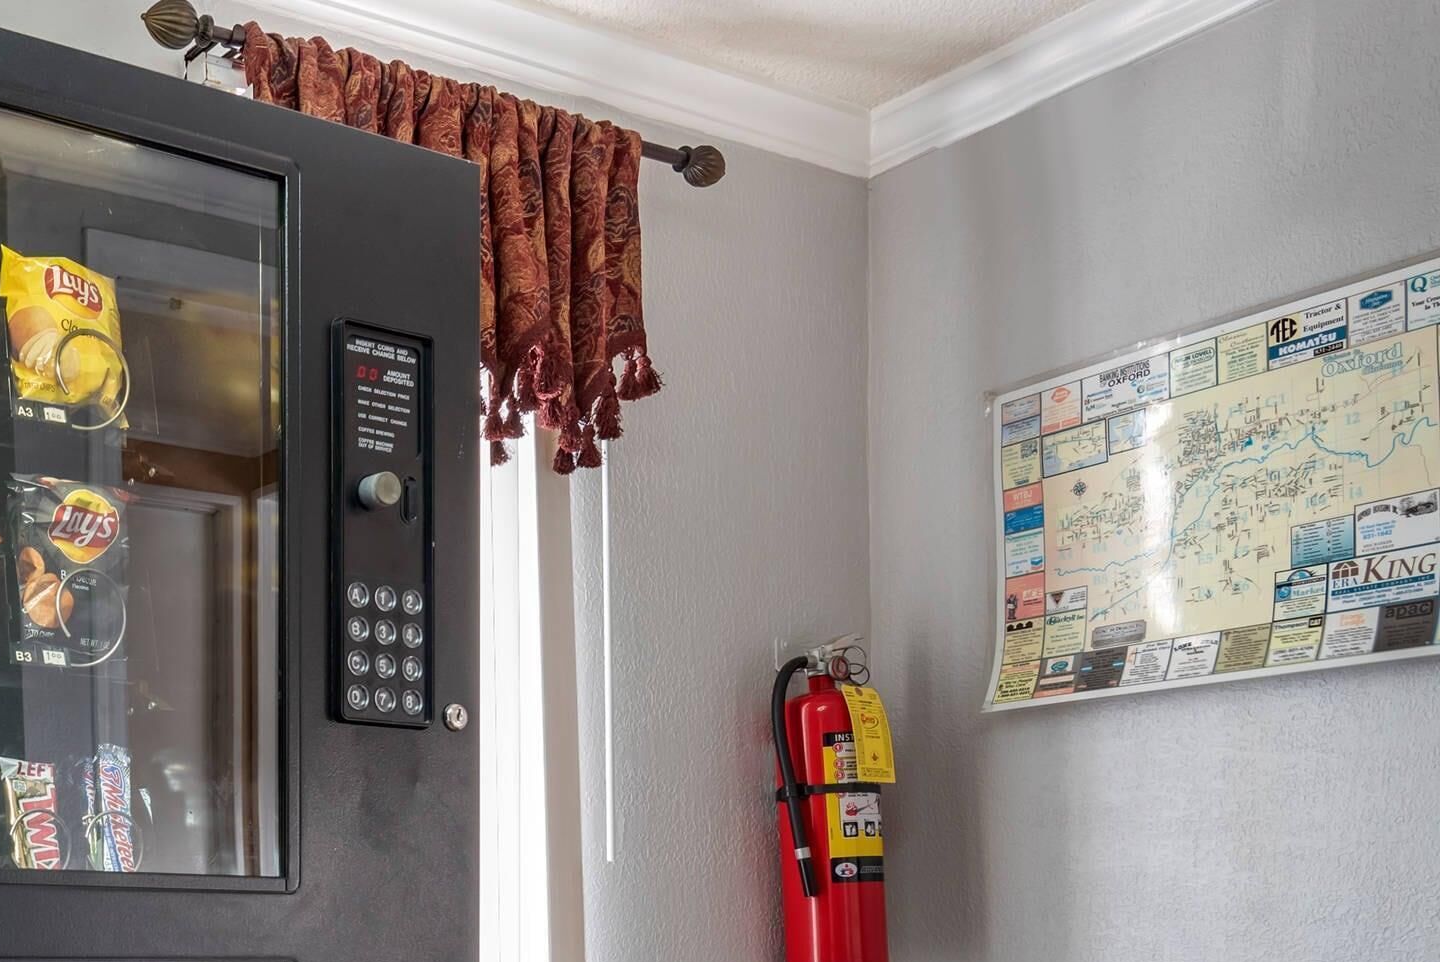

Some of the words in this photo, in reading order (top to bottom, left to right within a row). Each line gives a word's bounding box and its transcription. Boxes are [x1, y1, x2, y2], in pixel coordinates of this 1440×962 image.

[51, 265, 100, 306] Lay's
[1304, 306, 1333, 320] Tractor
[1270, 317, 1298, 343] TEC
[1303, 315, 1344, 333] Equipment
[396, 348, 408, 356] AND
[1279, 332, 1337, 356] KOMATSU
[371, 349, 395, 360] CHANGE
[396, 354, 417, 364] BELOW
[1321, 341, 1403, 378] Oxford
[383, 375, 415, 387] DEPOSITED
[386, 369, 411, 380] AMOUNT
[1107, 369, 1151, 388] OXFORD
[17, 406, 34, 417] A3
[51, 505, 115, 547] Lay's
[1360, 552, 1437, 584] KING
[1332, 577, 1359, 589] ERA
[1385, 603, 1430, 619] apac
[15, 651, 33, 662] B3
[17, 761, 56, 777] LEFT
